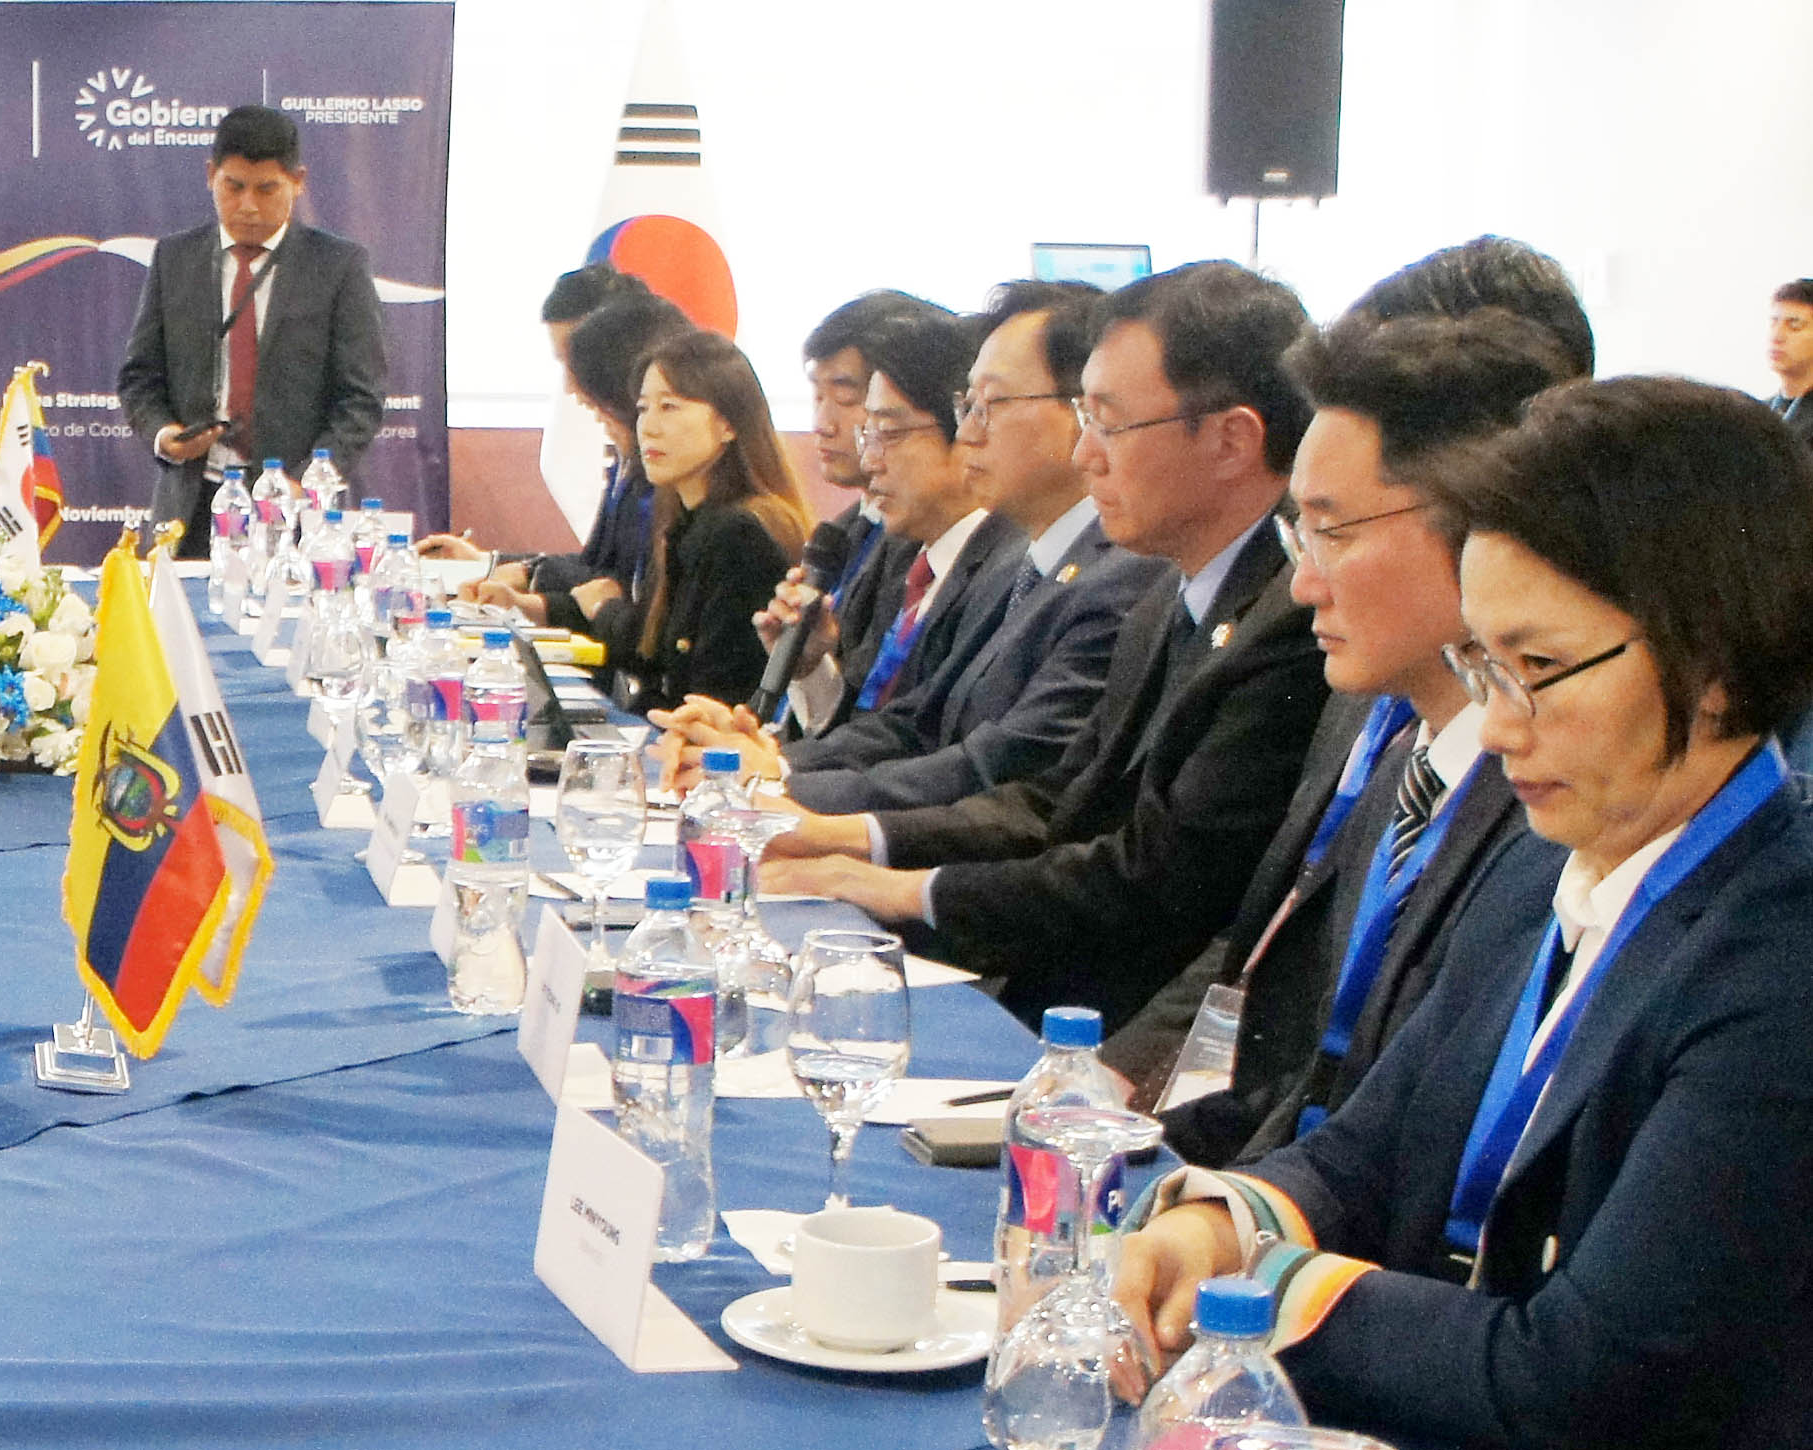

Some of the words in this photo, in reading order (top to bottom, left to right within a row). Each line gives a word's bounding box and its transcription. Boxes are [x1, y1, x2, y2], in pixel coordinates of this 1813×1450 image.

[281, 97, 370, 111] GUILLERMO
[372, 97, 424, 111] LASSO
[106, 99, 229, 126] Gobiern
[305, 111, 399, 124] PRESIDENTE
[128, 132, 150, 146] del
[56, 392, 122, 410] Strateg
[64, 422, 85, 438] de
[374, 426, 417, 439] orea
